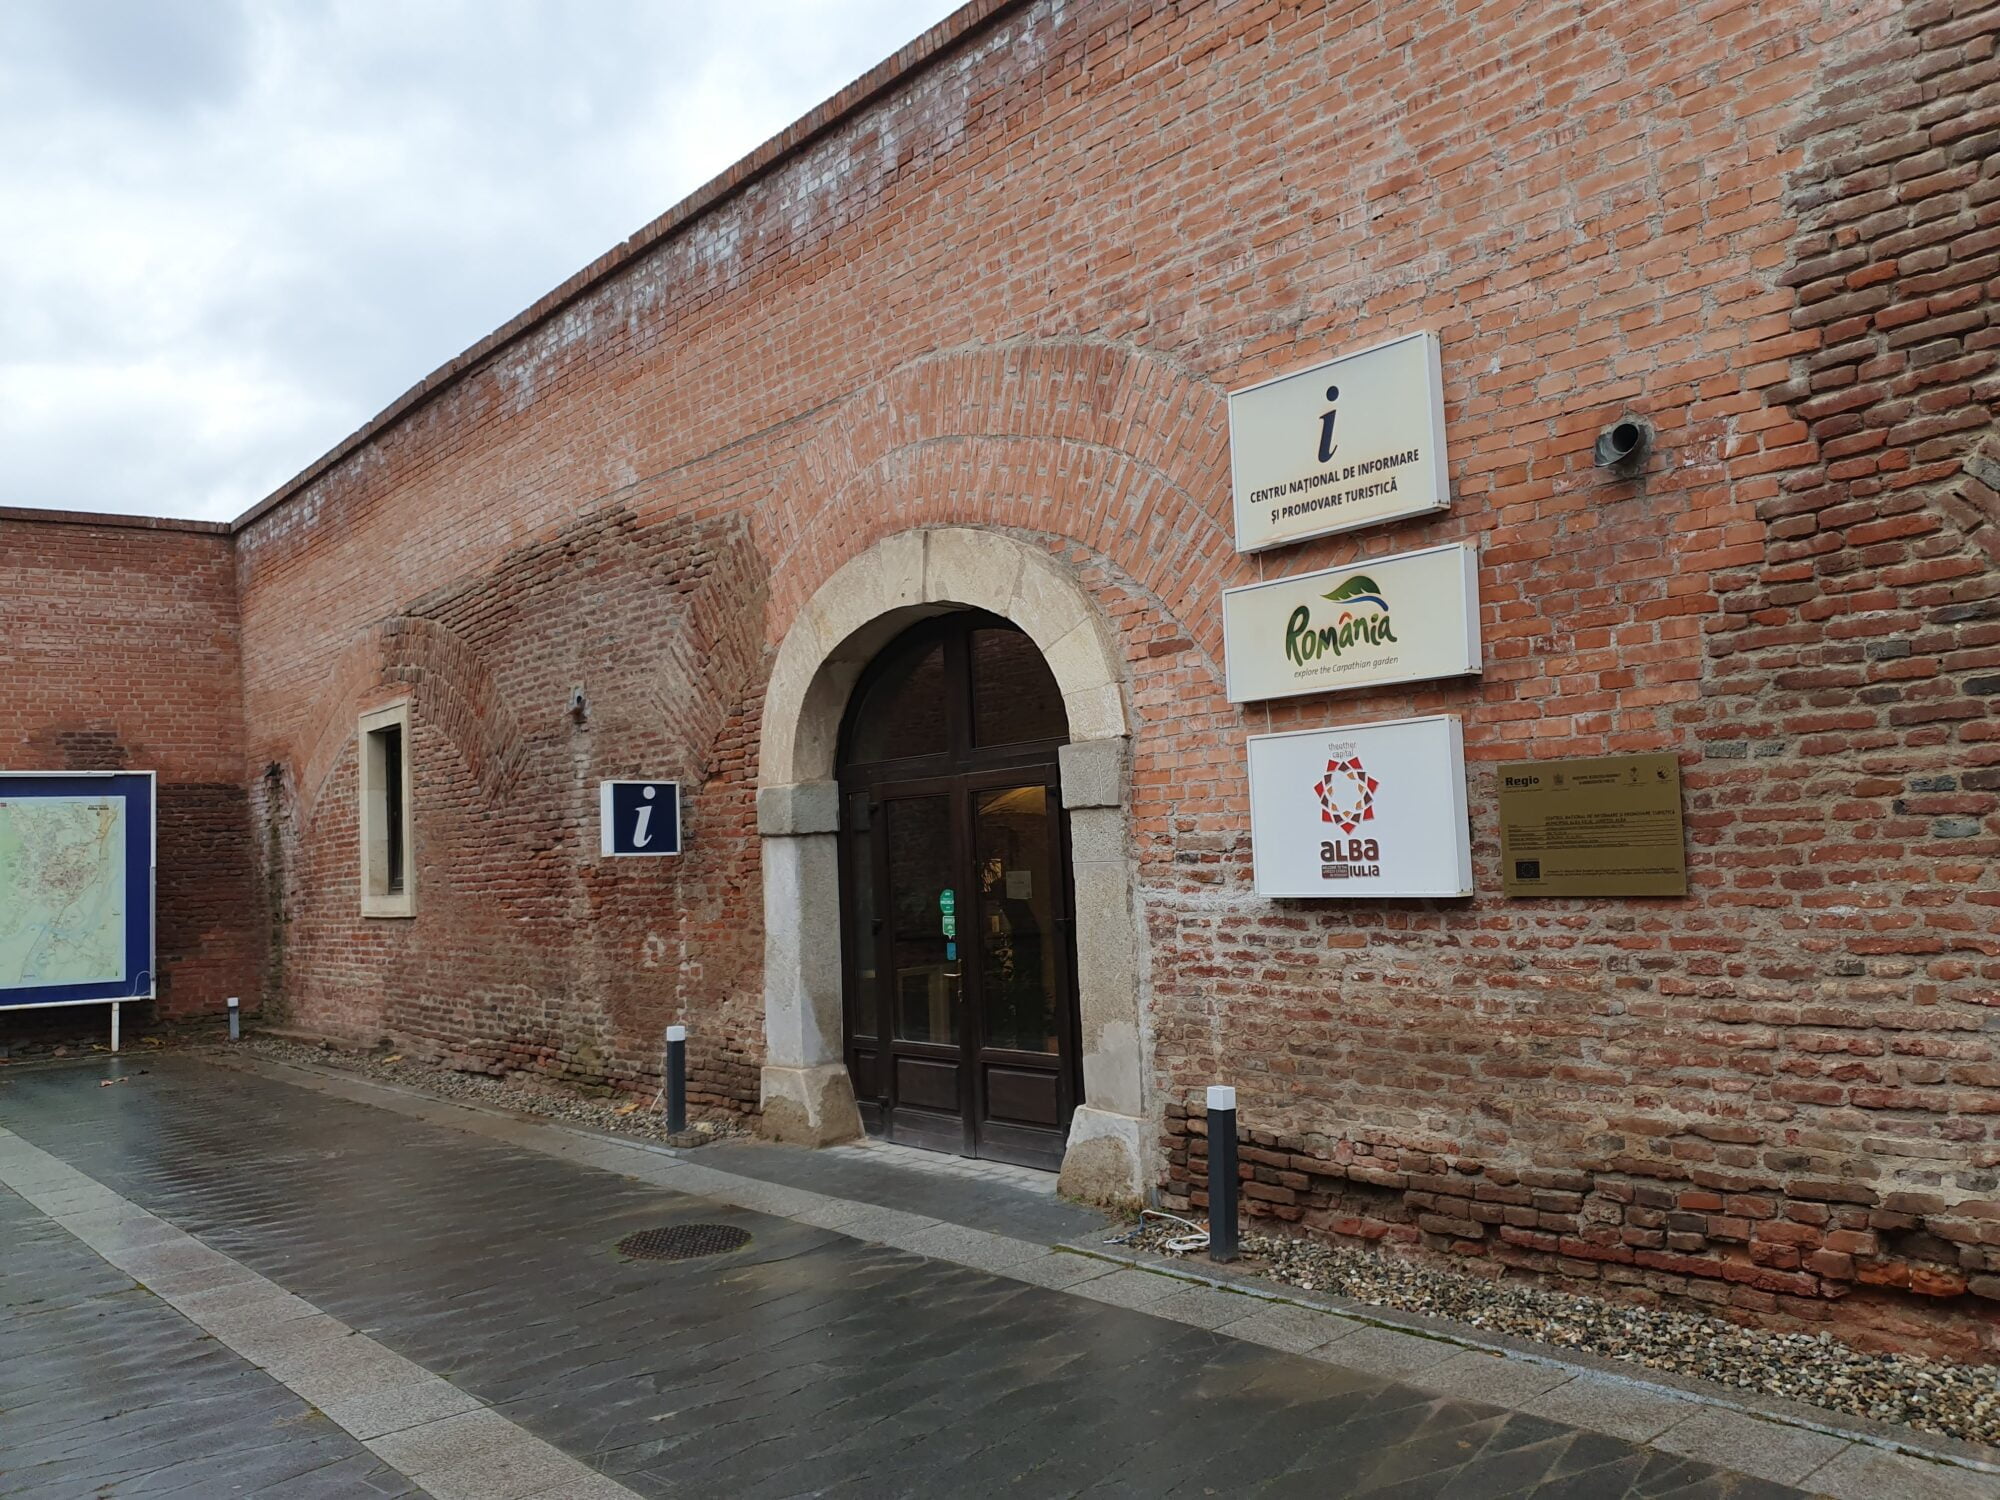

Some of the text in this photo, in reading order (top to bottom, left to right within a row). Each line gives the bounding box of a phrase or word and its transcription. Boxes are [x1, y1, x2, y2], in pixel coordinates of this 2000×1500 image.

[1318, 385, 1339, 463] i
[1250, 484, 1287, 503] CENTRU
[1343, 466, 1356, 480] DE
[1358, 449, 1420, 476] INFORMARE
[1282, 493, 1343, 519] PROMOVARE
[1345, 476, 1398, 503] TURISTICĂ
[1294, 656, 1399, 680] explore the Carpathian garden
[1332, 748, 1354, 759] capital
[1505, 776, 1540, 787] Regio
[633, 786, 656, 848] i
